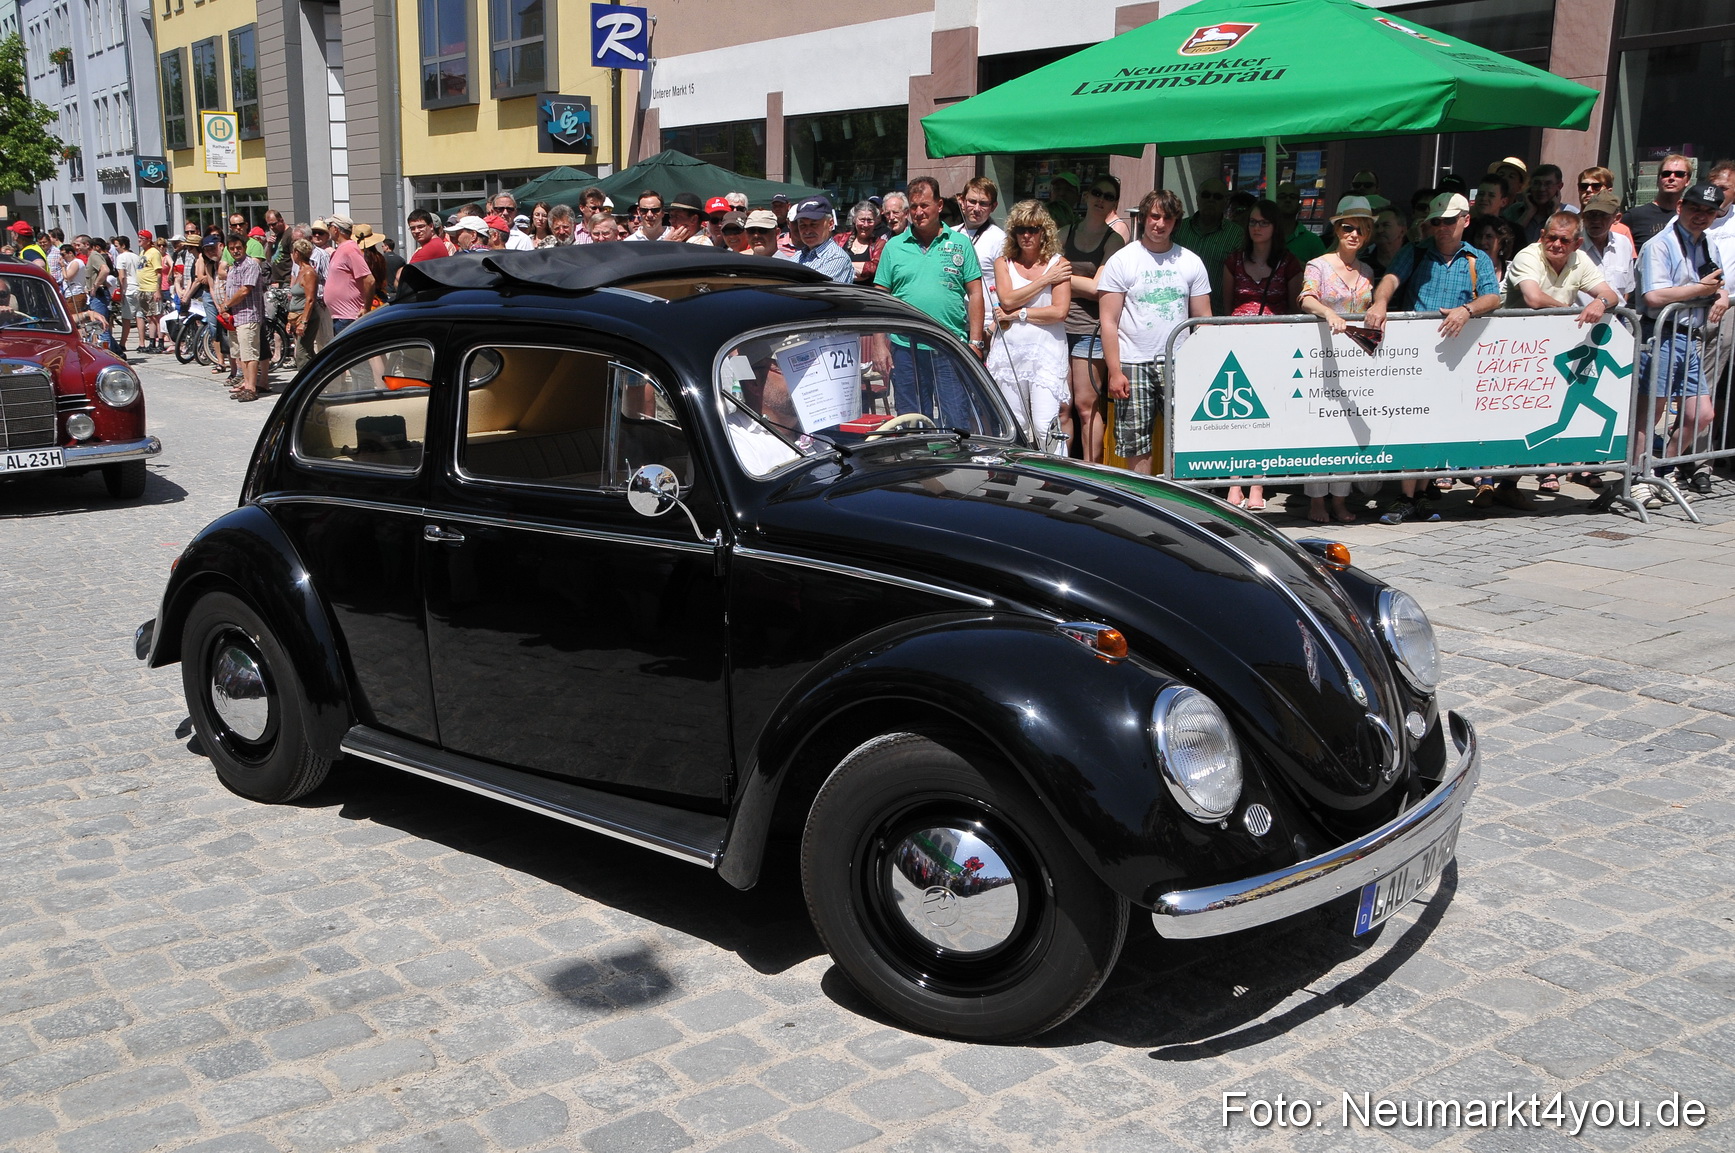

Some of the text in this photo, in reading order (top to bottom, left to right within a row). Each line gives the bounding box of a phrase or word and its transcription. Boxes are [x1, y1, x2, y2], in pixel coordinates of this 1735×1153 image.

[1113, 57, 1271, 78] Neumarkter
[1071, 67, 1288, 96] Lammsbräu
[652, 83, 695, 99] Unterer Markt 15
[214, 121, 226, 137] H
[560, 111, 578, 135] G2
[147, 164, 159, 178] G2
[1510, 338, 1550, 355] UNS
[829, 348, 854, 370] 224
[1309, 365, 1423, 379] Hausmeisterdienste
[1308, 386, 1375, 399] Mietservice
[1318, 405, 1430, 418] Event-Leit-Systeme
[1475, 394, 1552, 412] BESSER.
[1189, 423, 1202, 431] Jura
[1203, 423, 1229, 431] Gebäude
[1230, 422, 1251, 430] Servic
[1188, 451, 1394, 472] www.jura-gebaeudeservice.de
[1371, 867, 1409, 922] LAU
